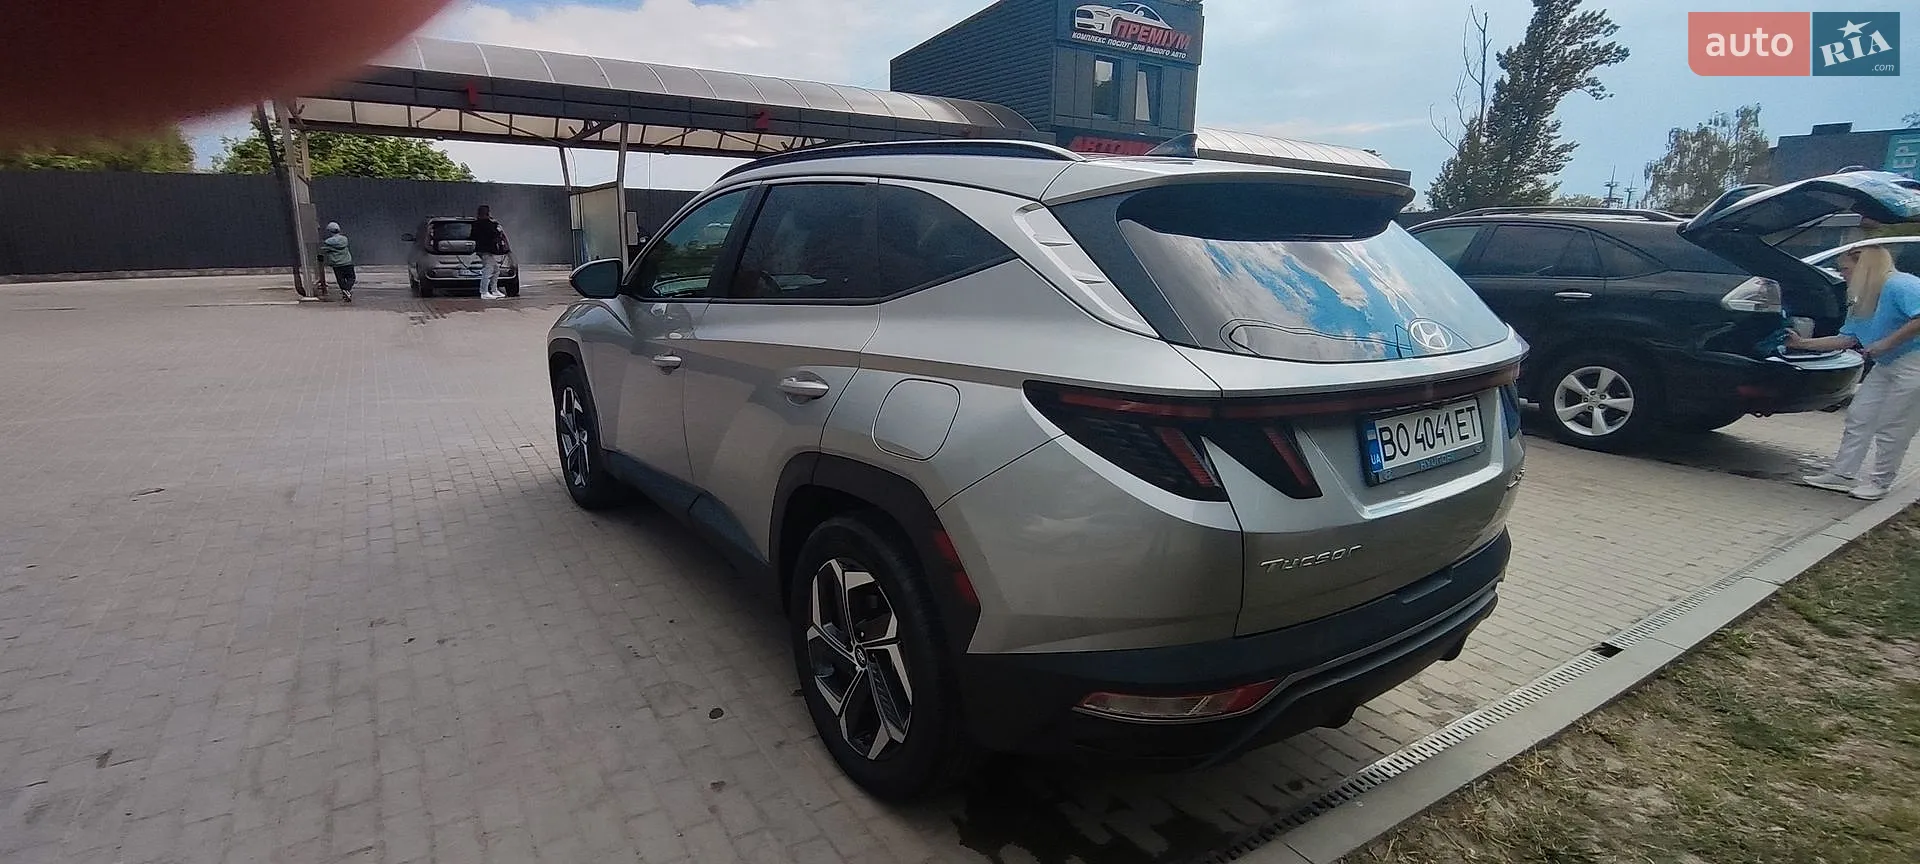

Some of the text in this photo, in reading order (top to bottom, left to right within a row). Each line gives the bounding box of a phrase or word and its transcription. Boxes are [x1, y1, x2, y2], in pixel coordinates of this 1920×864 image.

[1072, 31, 1187, 59] КОМПЛЕКС ПОСЛУГ ДЛЯ ВАШОГО АВТО
[1113, 21, 1192, 49] ПРЕМІУМ
[1379, 406, 1476, 462] BO 4041 ET
[1370, 454, 1381, 465] UA
